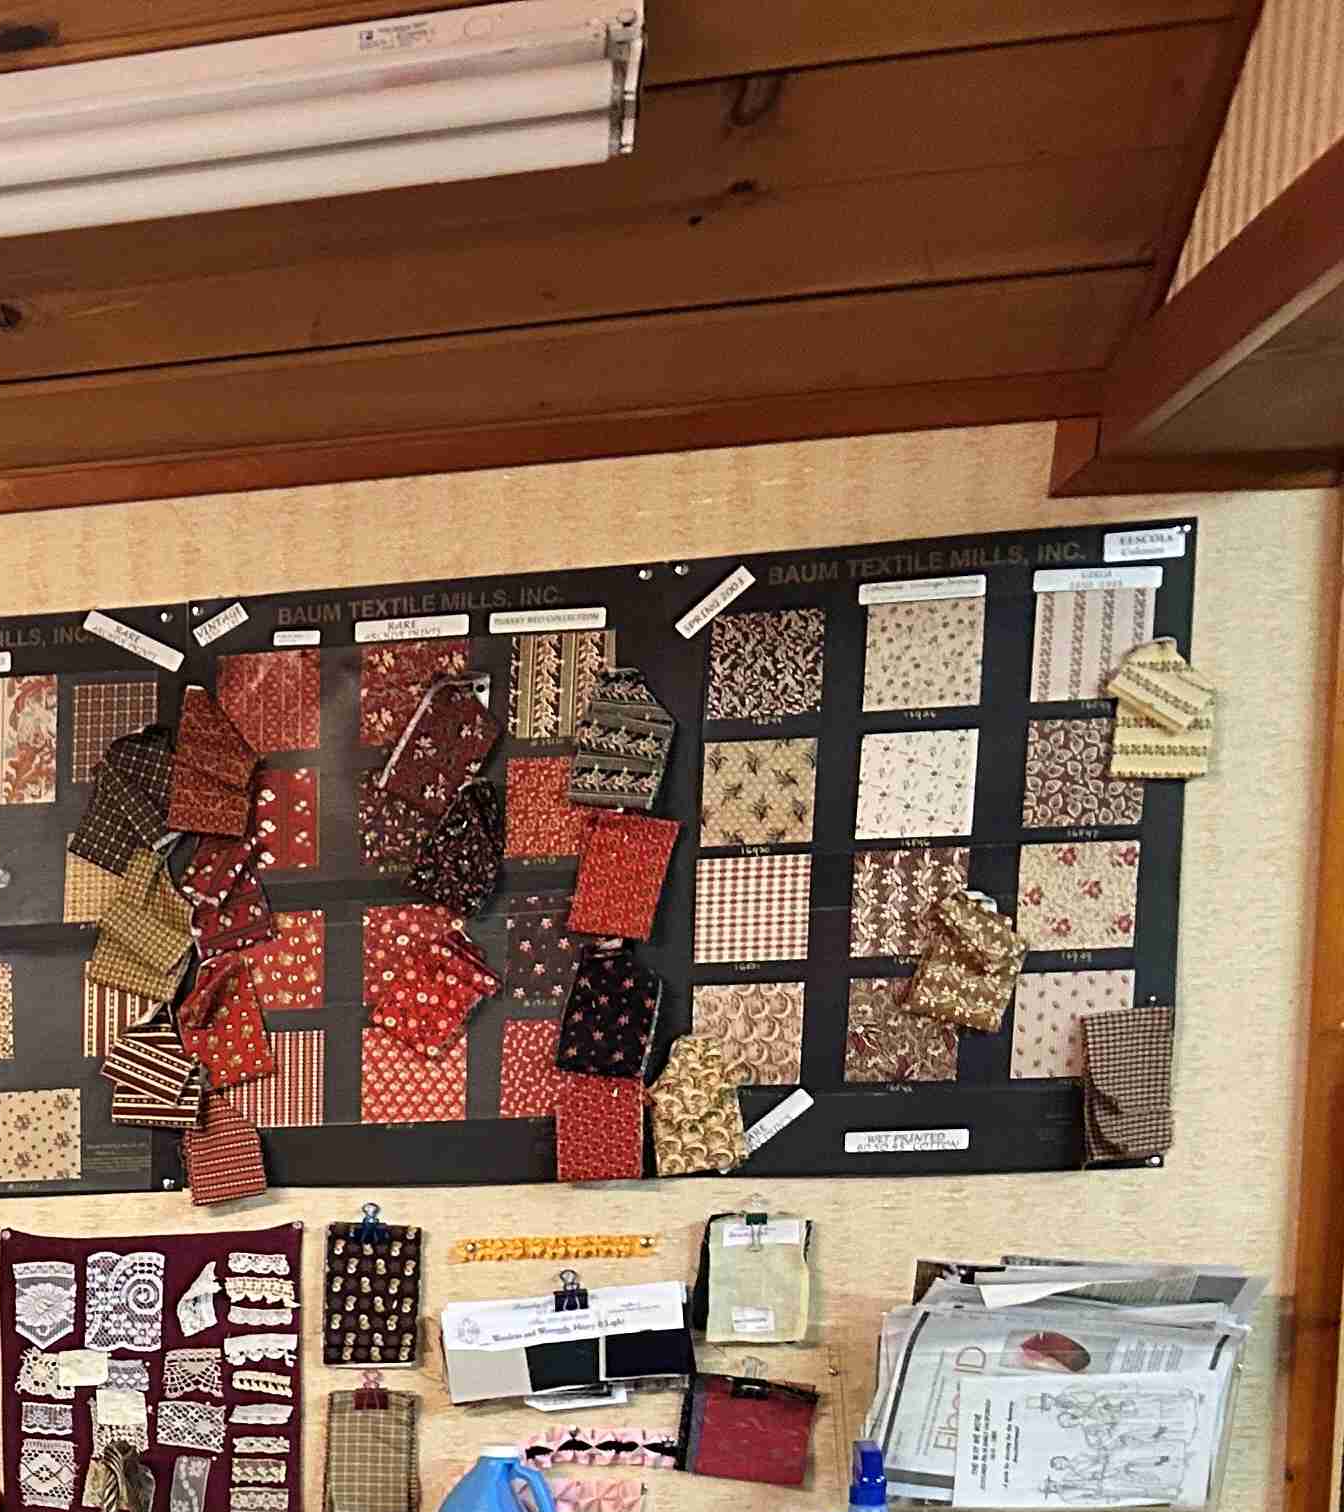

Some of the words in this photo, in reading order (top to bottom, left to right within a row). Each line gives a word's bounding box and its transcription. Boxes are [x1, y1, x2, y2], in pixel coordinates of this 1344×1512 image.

[768, 562, 838, 585] BAUM
[846, 552, 945, 579] TEXTILE
[950, 547, 1028, 571] MILLS,
[1037, 541, 1086, 563] INC.
[278, 602, 342, 626] BAUM
[349, 595, 437, 618] TEXTILE
[520, 585, 562, 605] INC.
[53, 625, 96, 646] INC.
